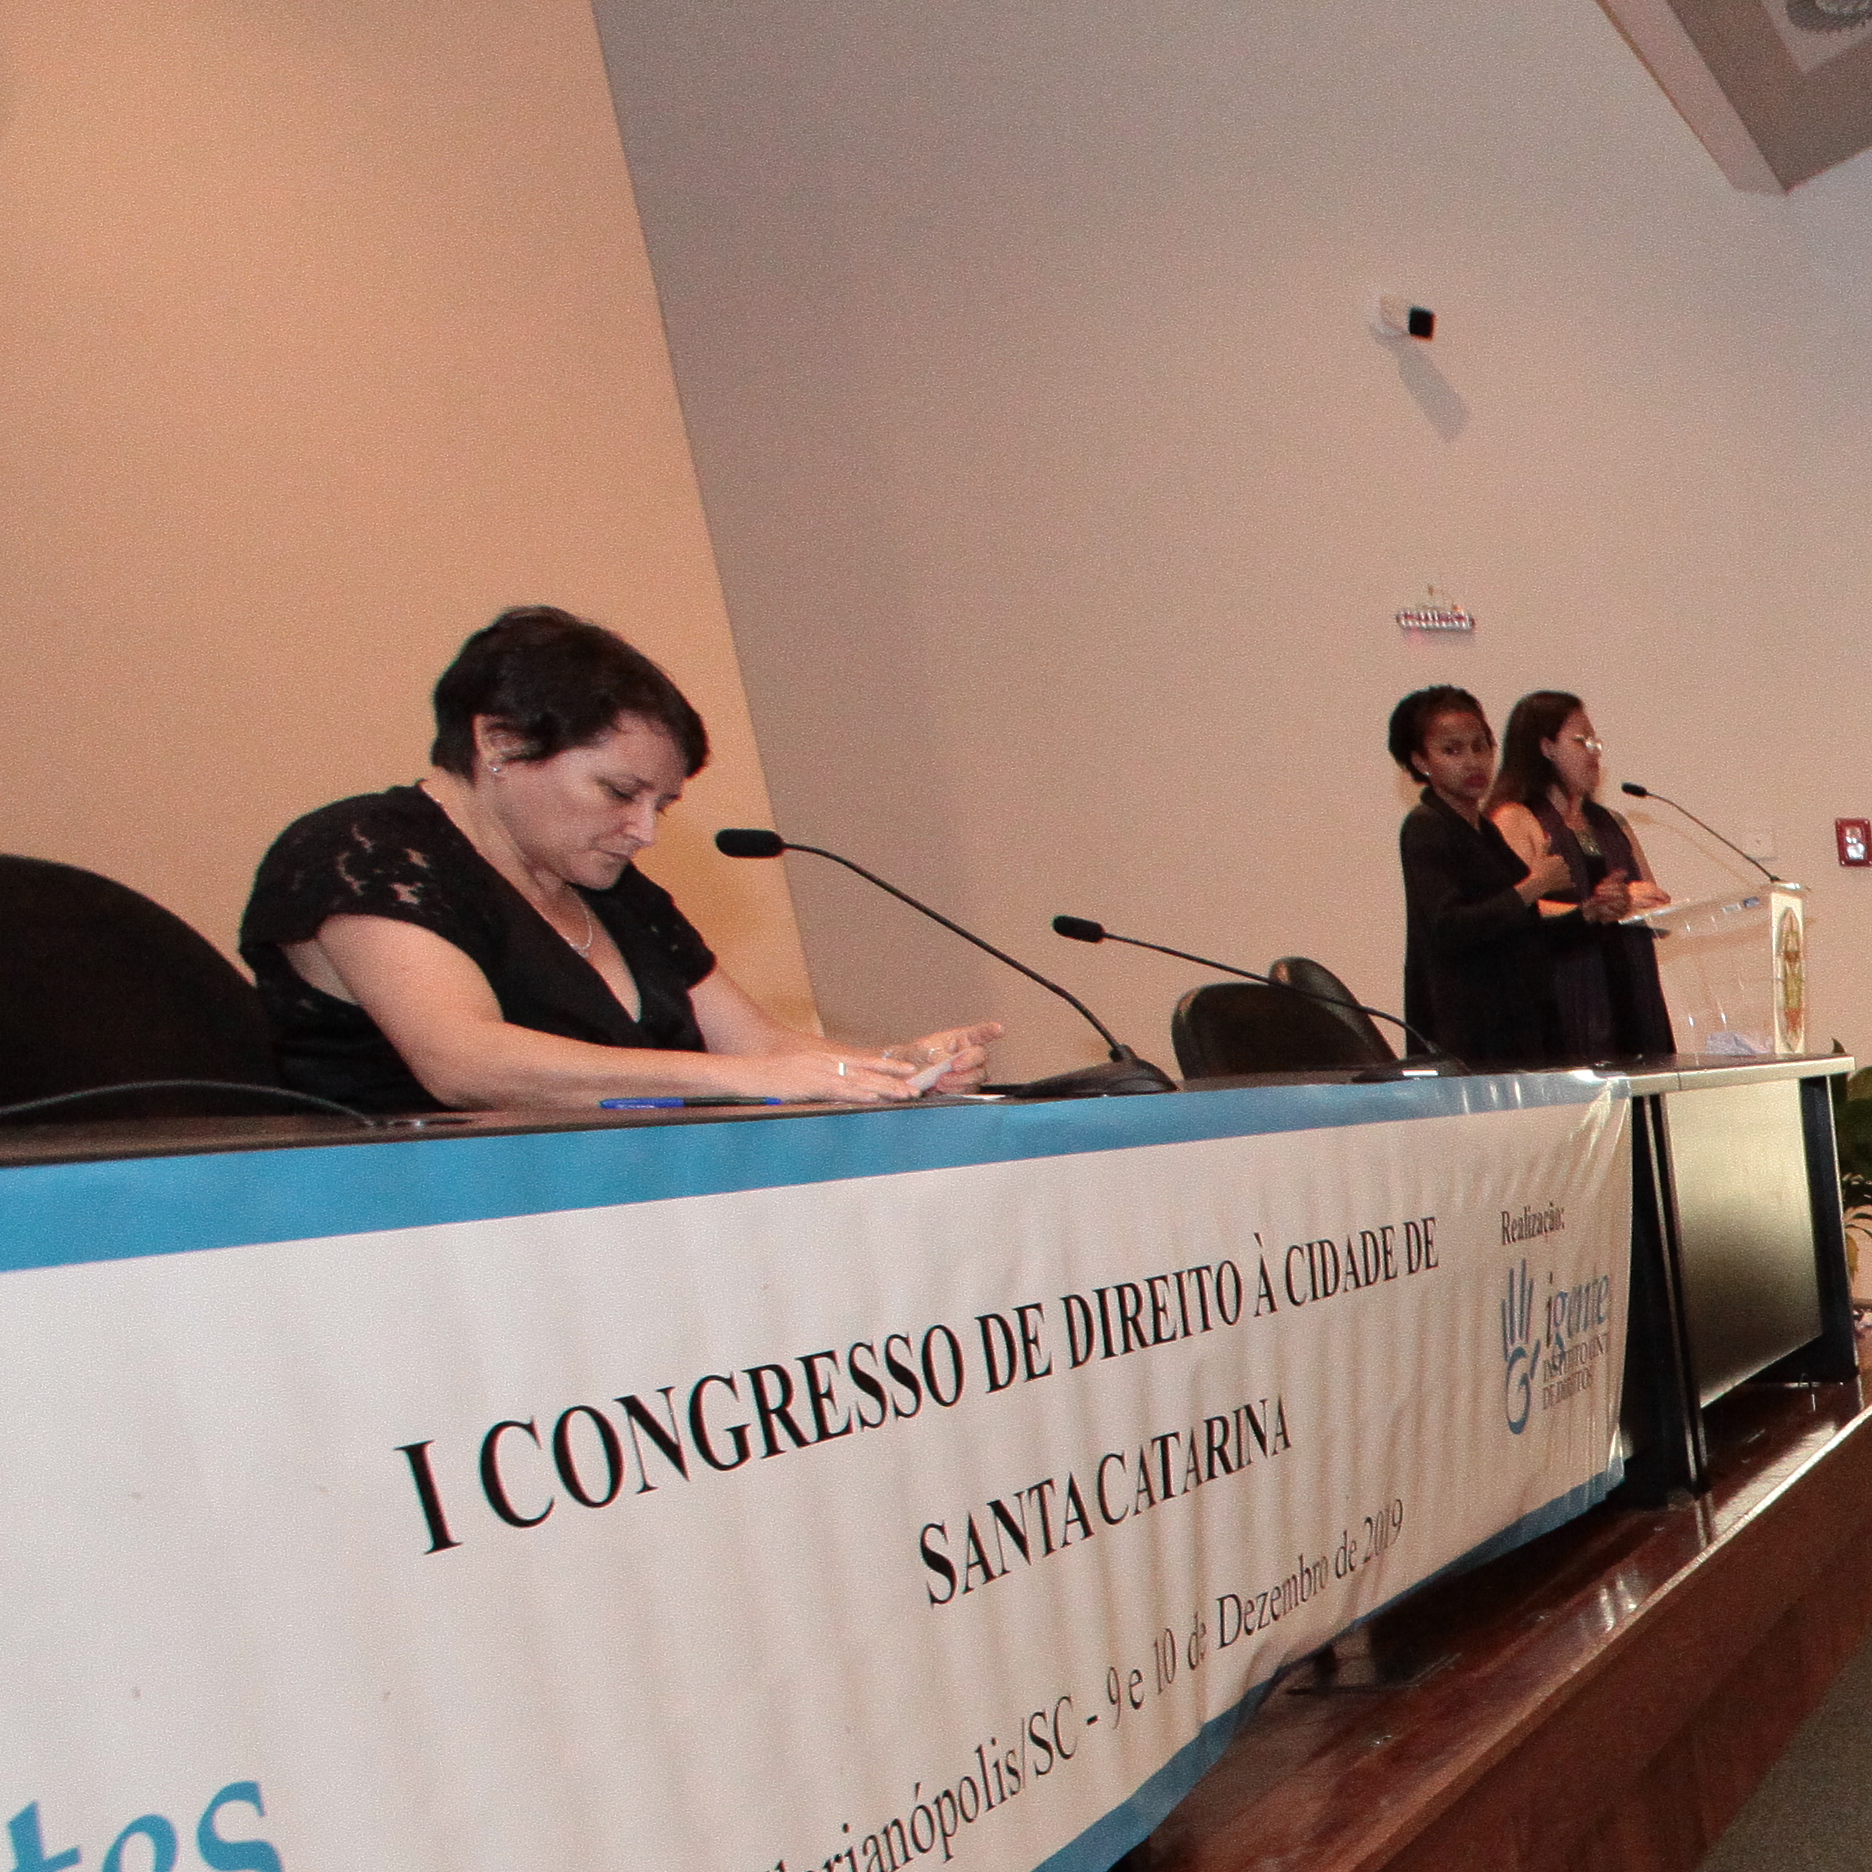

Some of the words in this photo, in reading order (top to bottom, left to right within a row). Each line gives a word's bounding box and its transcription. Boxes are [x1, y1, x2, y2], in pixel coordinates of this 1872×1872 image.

[393, 1440, 463, 1555] I
[478, 1323, 965, 1528] CONGRESSO
[974, 1302, 1053, 1394] DE
[1060, 1259, 1245, 1370] DIREITO
[1252, 1232, 1279, 1318] À
[1284, 1225, 1400, 1307] CIDADE
[1403, 1216, 1440, 1275] DE
[919, 1471, 1096, 1609] SANTA
[1096, 1394, 1292, 1526] CATARINA
[1106, 1666, 1121, 1729] 9
[1128, 1668, 1145, 1710] e
[1154, 1628, 1177, 1695] 10
[1216, 1555, 1329, 1650] Dezembro
[1335, 1530, 1358, 1579] de
[1363, 1499, 1403, 1564] 2019
